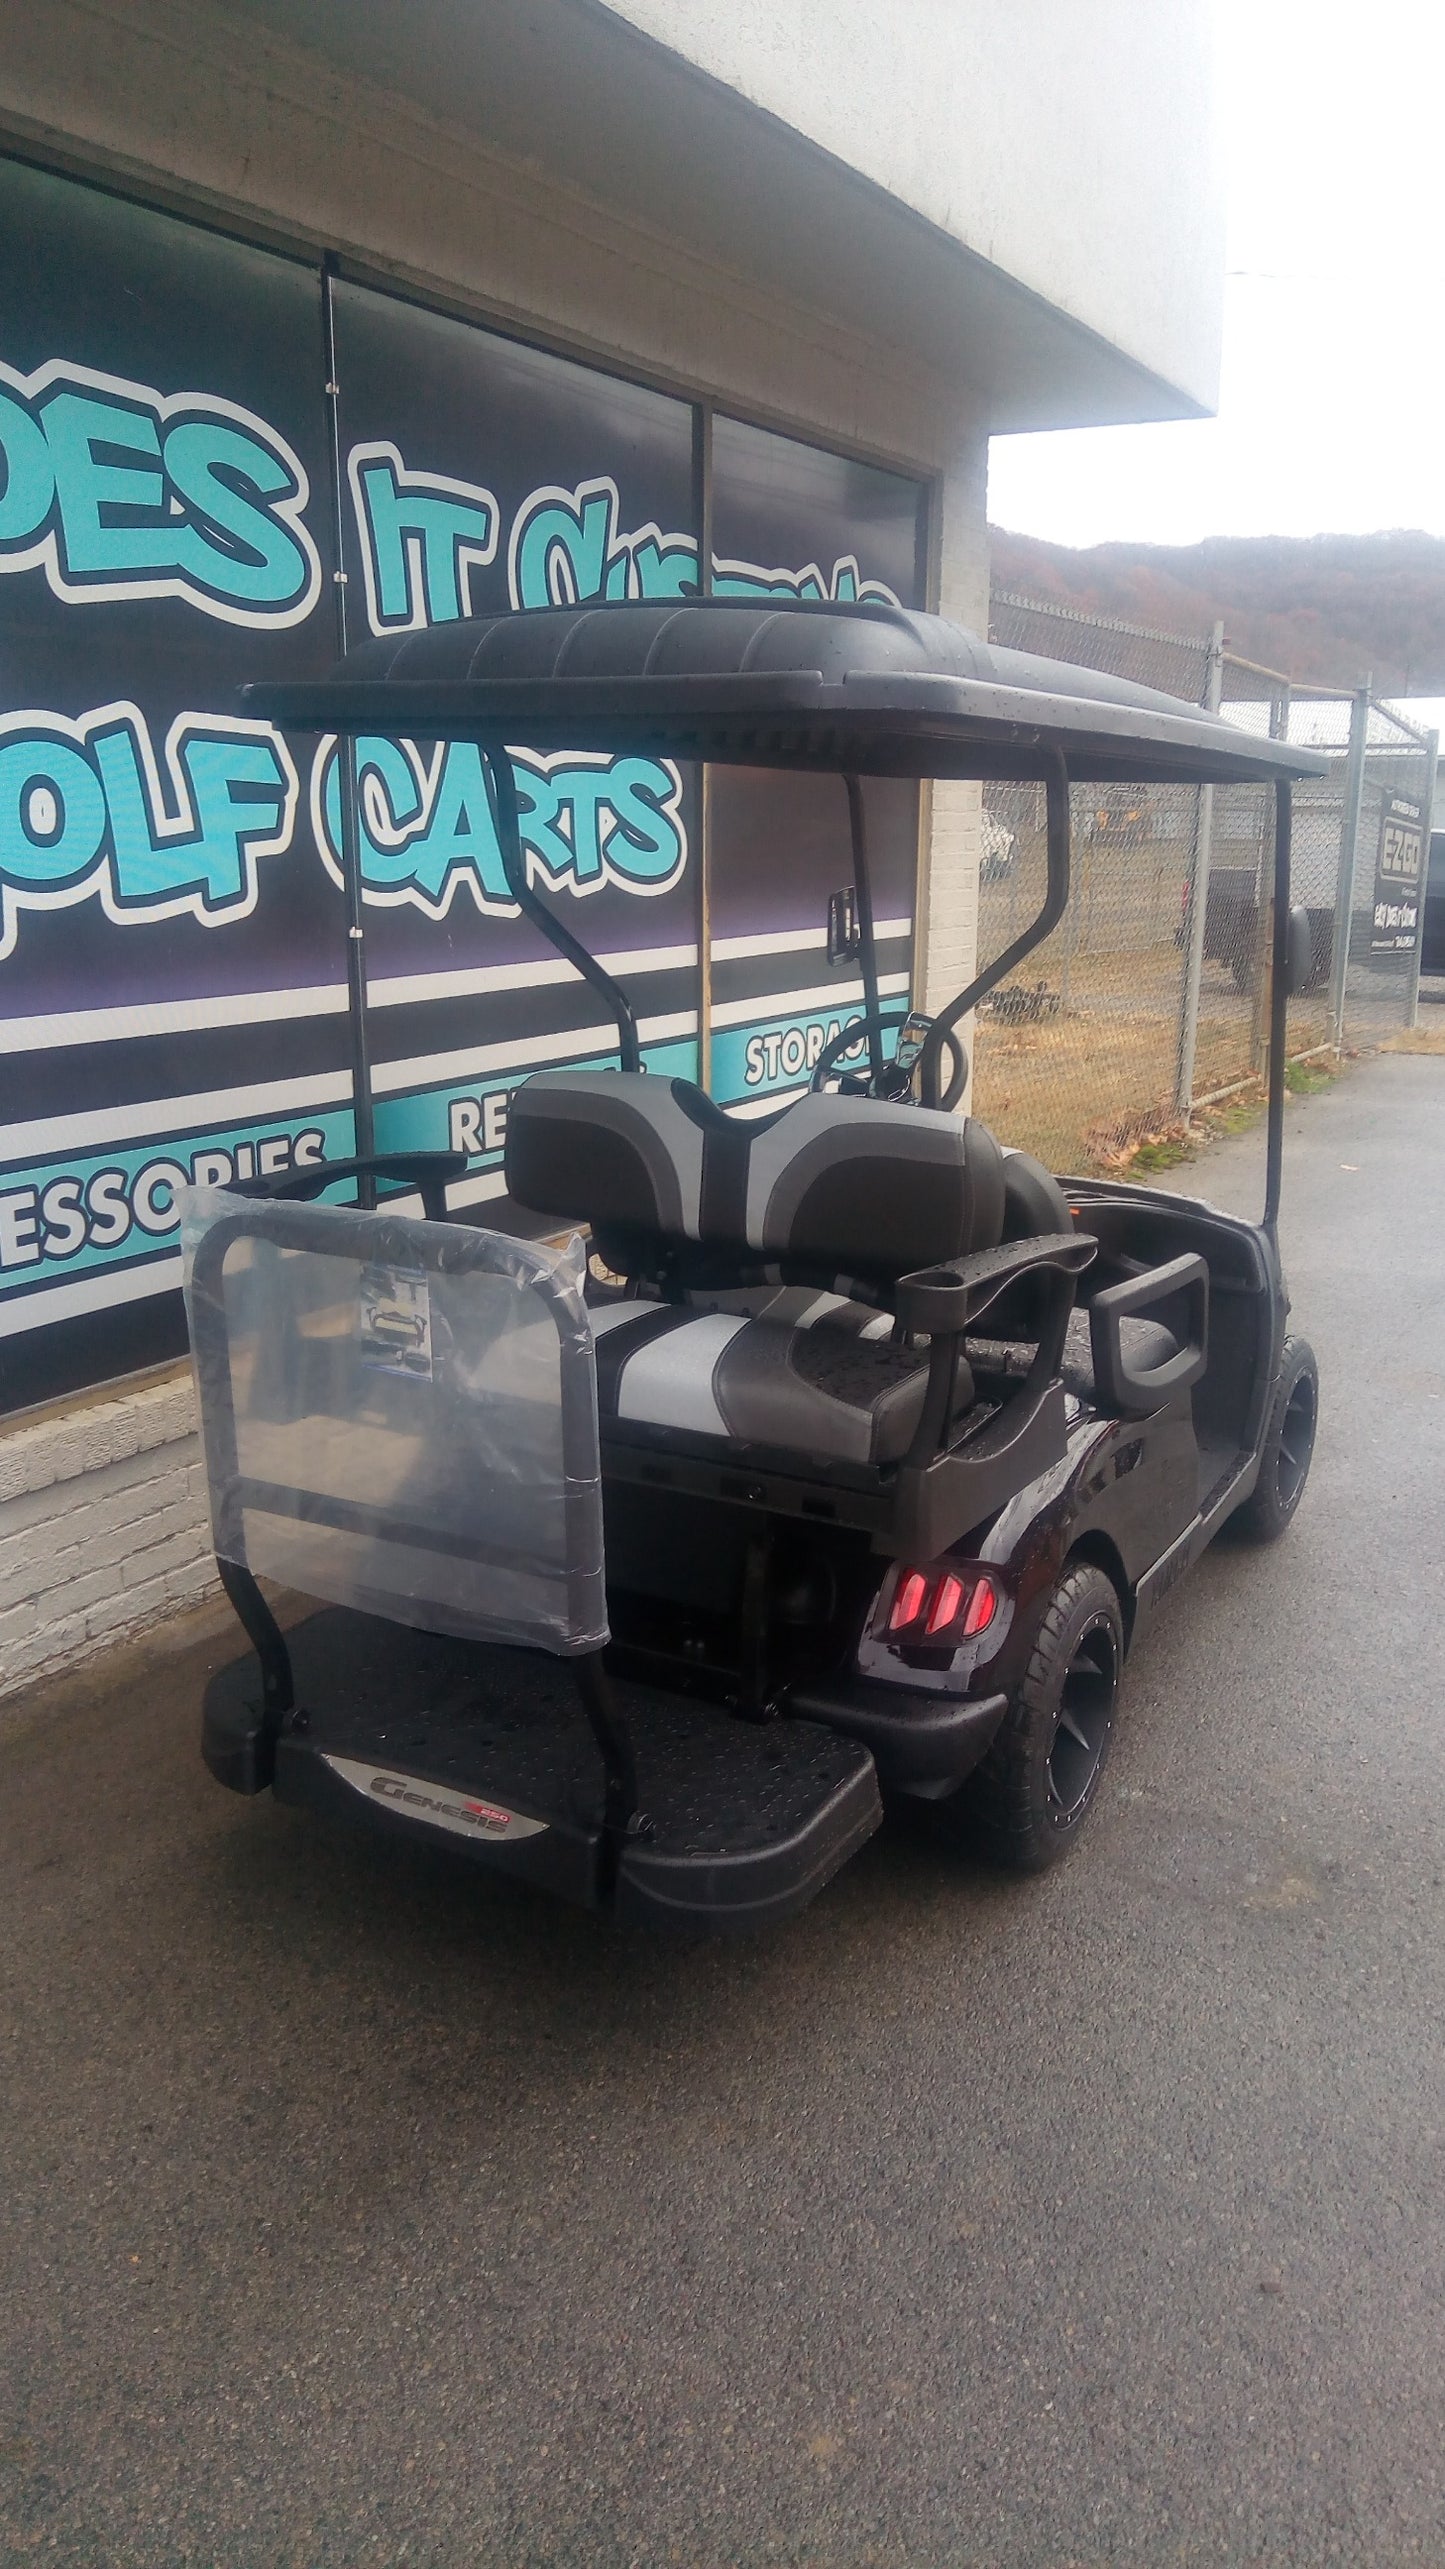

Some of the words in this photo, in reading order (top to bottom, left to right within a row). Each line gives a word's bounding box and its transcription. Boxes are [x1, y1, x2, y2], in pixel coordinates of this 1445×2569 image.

[358, 460, 492, 626] IT
[0, 724, 288, 904] OLF
[322, 733, 682, 900] CARTS
[744, 1017, 870, 1085] STORAG
[480, 1807, 509, 1823] 250
